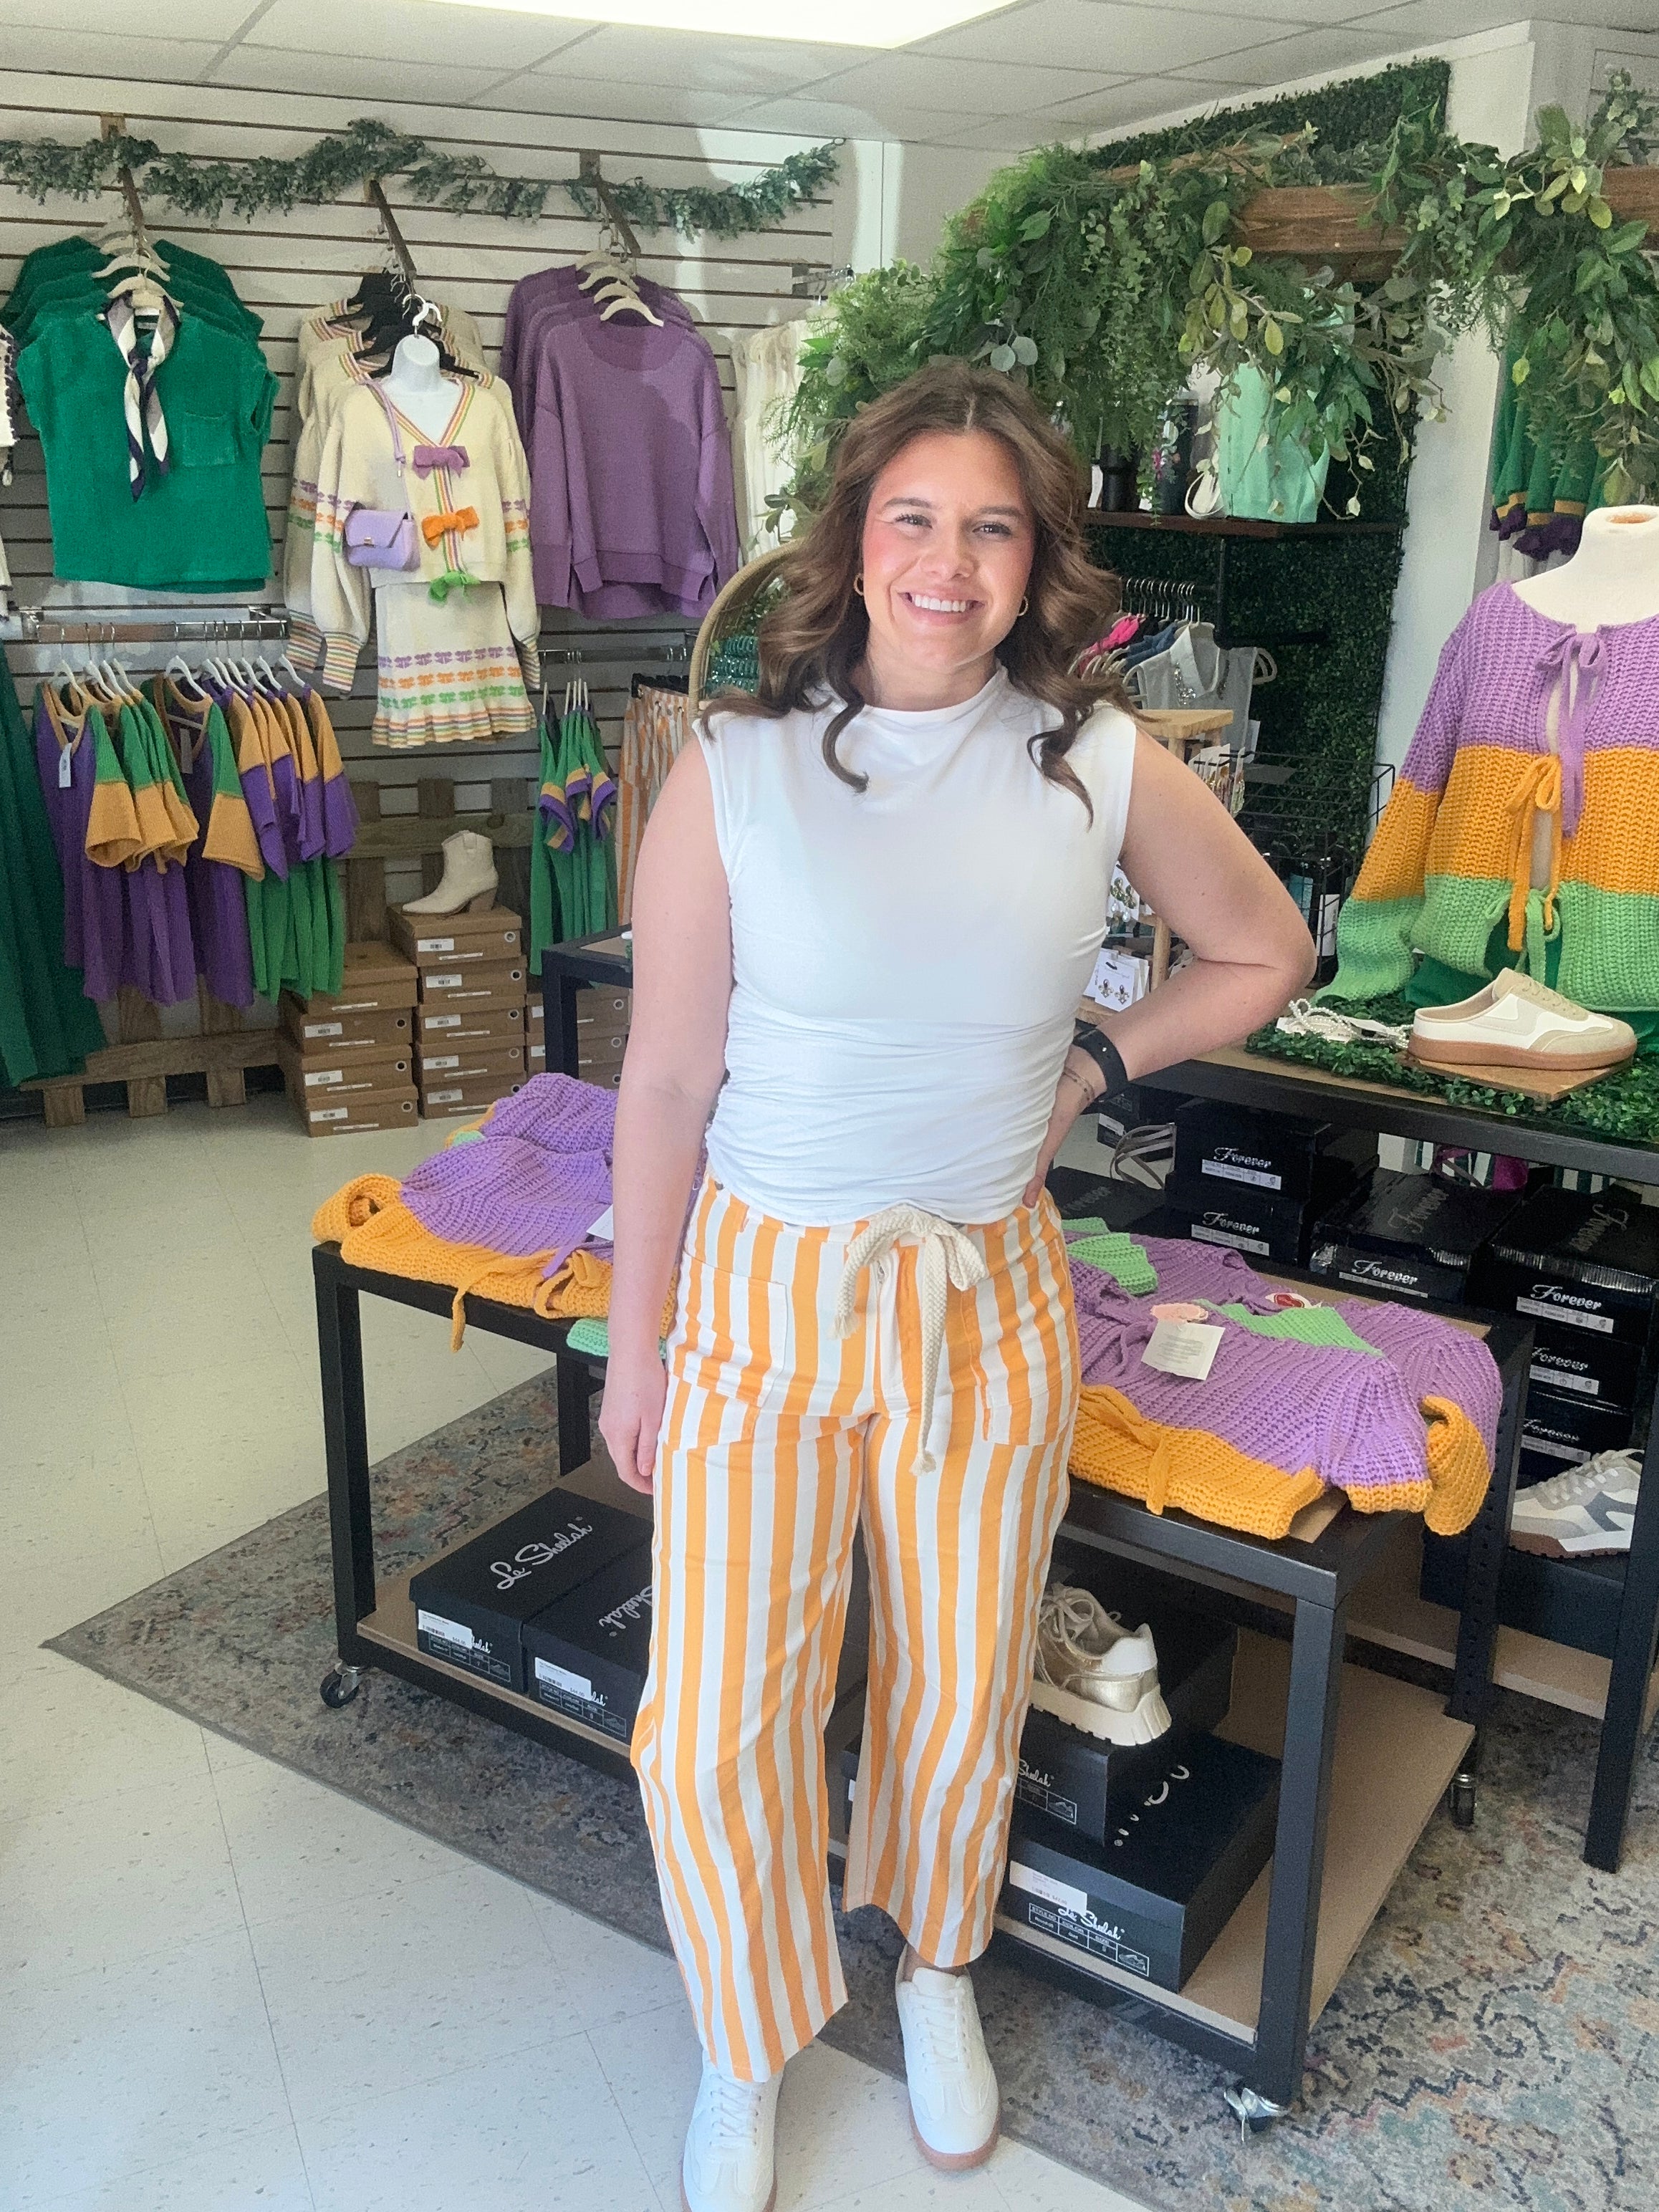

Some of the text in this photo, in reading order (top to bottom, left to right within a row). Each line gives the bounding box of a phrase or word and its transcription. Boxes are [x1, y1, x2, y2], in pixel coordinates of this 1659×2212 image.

[1213, 1147, 1271, 1168] Forever
[1202, 1211, 1260, 1234] Forever
[1351, 1259, 1418, 1285] Forever
[1530, 1284, 1602, 1310] Forever
